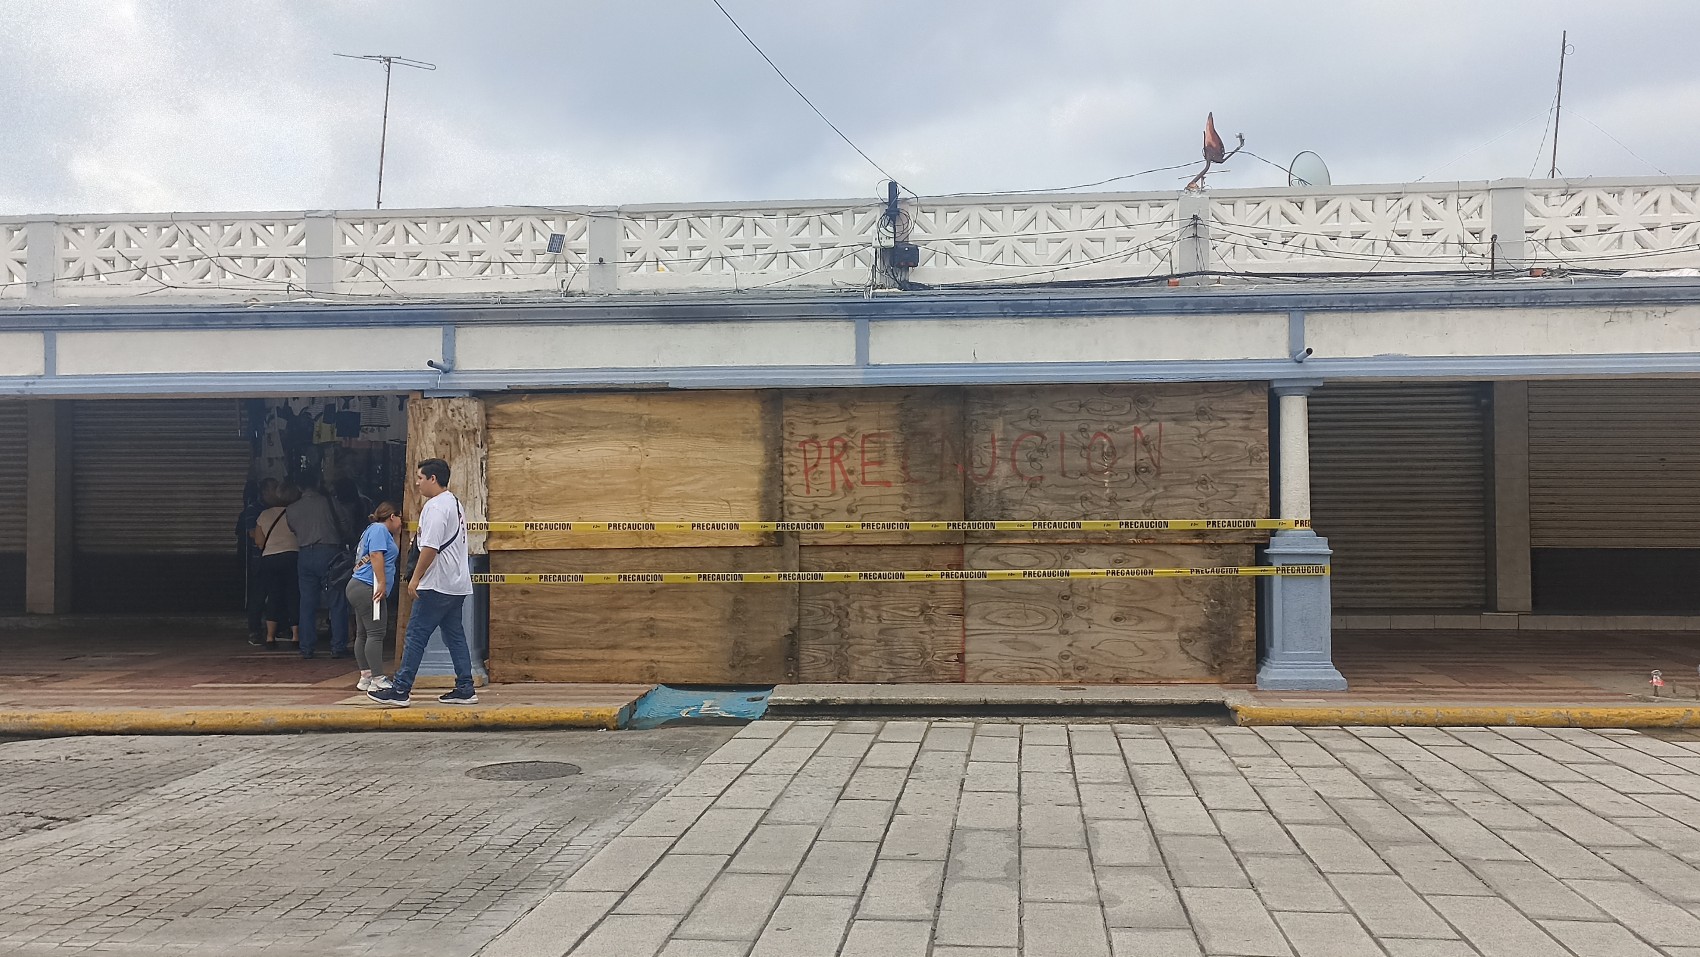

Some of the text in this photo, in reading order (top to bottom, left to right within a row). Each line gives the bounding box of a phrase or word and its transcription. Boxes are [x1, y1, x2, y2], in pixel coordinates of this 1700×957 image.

[466, 522, 489, 531] UCION
[524, 522, 572, 531] PRECAUCION
[607, 522, 655, 531] PRECAUCION
[691, 522, 740, 531] PRECAUCION
[775, 522, 825, 531] PRECAUCION
[860, 522, 910, 530] PRECAUCION
[946, 521, 996, 530] PRECAUCION
[1032, 521, 1082, 529] PRECAUCION
[1119, 520, 1169, 529] PRECAUCION
[1206, 520, 1257, 528] PRECAUCION
[470, 574, 505, 583] ECAUCION
[538, 574, 584, 583] PRECAUCION
[617, 574, 664, 582] PRECAUCION
[697, 573, 744, 582] PRECAUCION
[777, 573, 824, 581] PRECAUCION
[858, 572, 905, 580] PRECAUCION
[940, 571, 987, 579] PRECAUCION
[1022, 570, 1070, 578] PRECAUCION
[1105, 569, 1154, 577] PRECAUCION
[1190, 567, 1239, 575] PRECAUCION
[1275, 565, 1326, 575] PRECAUCION
